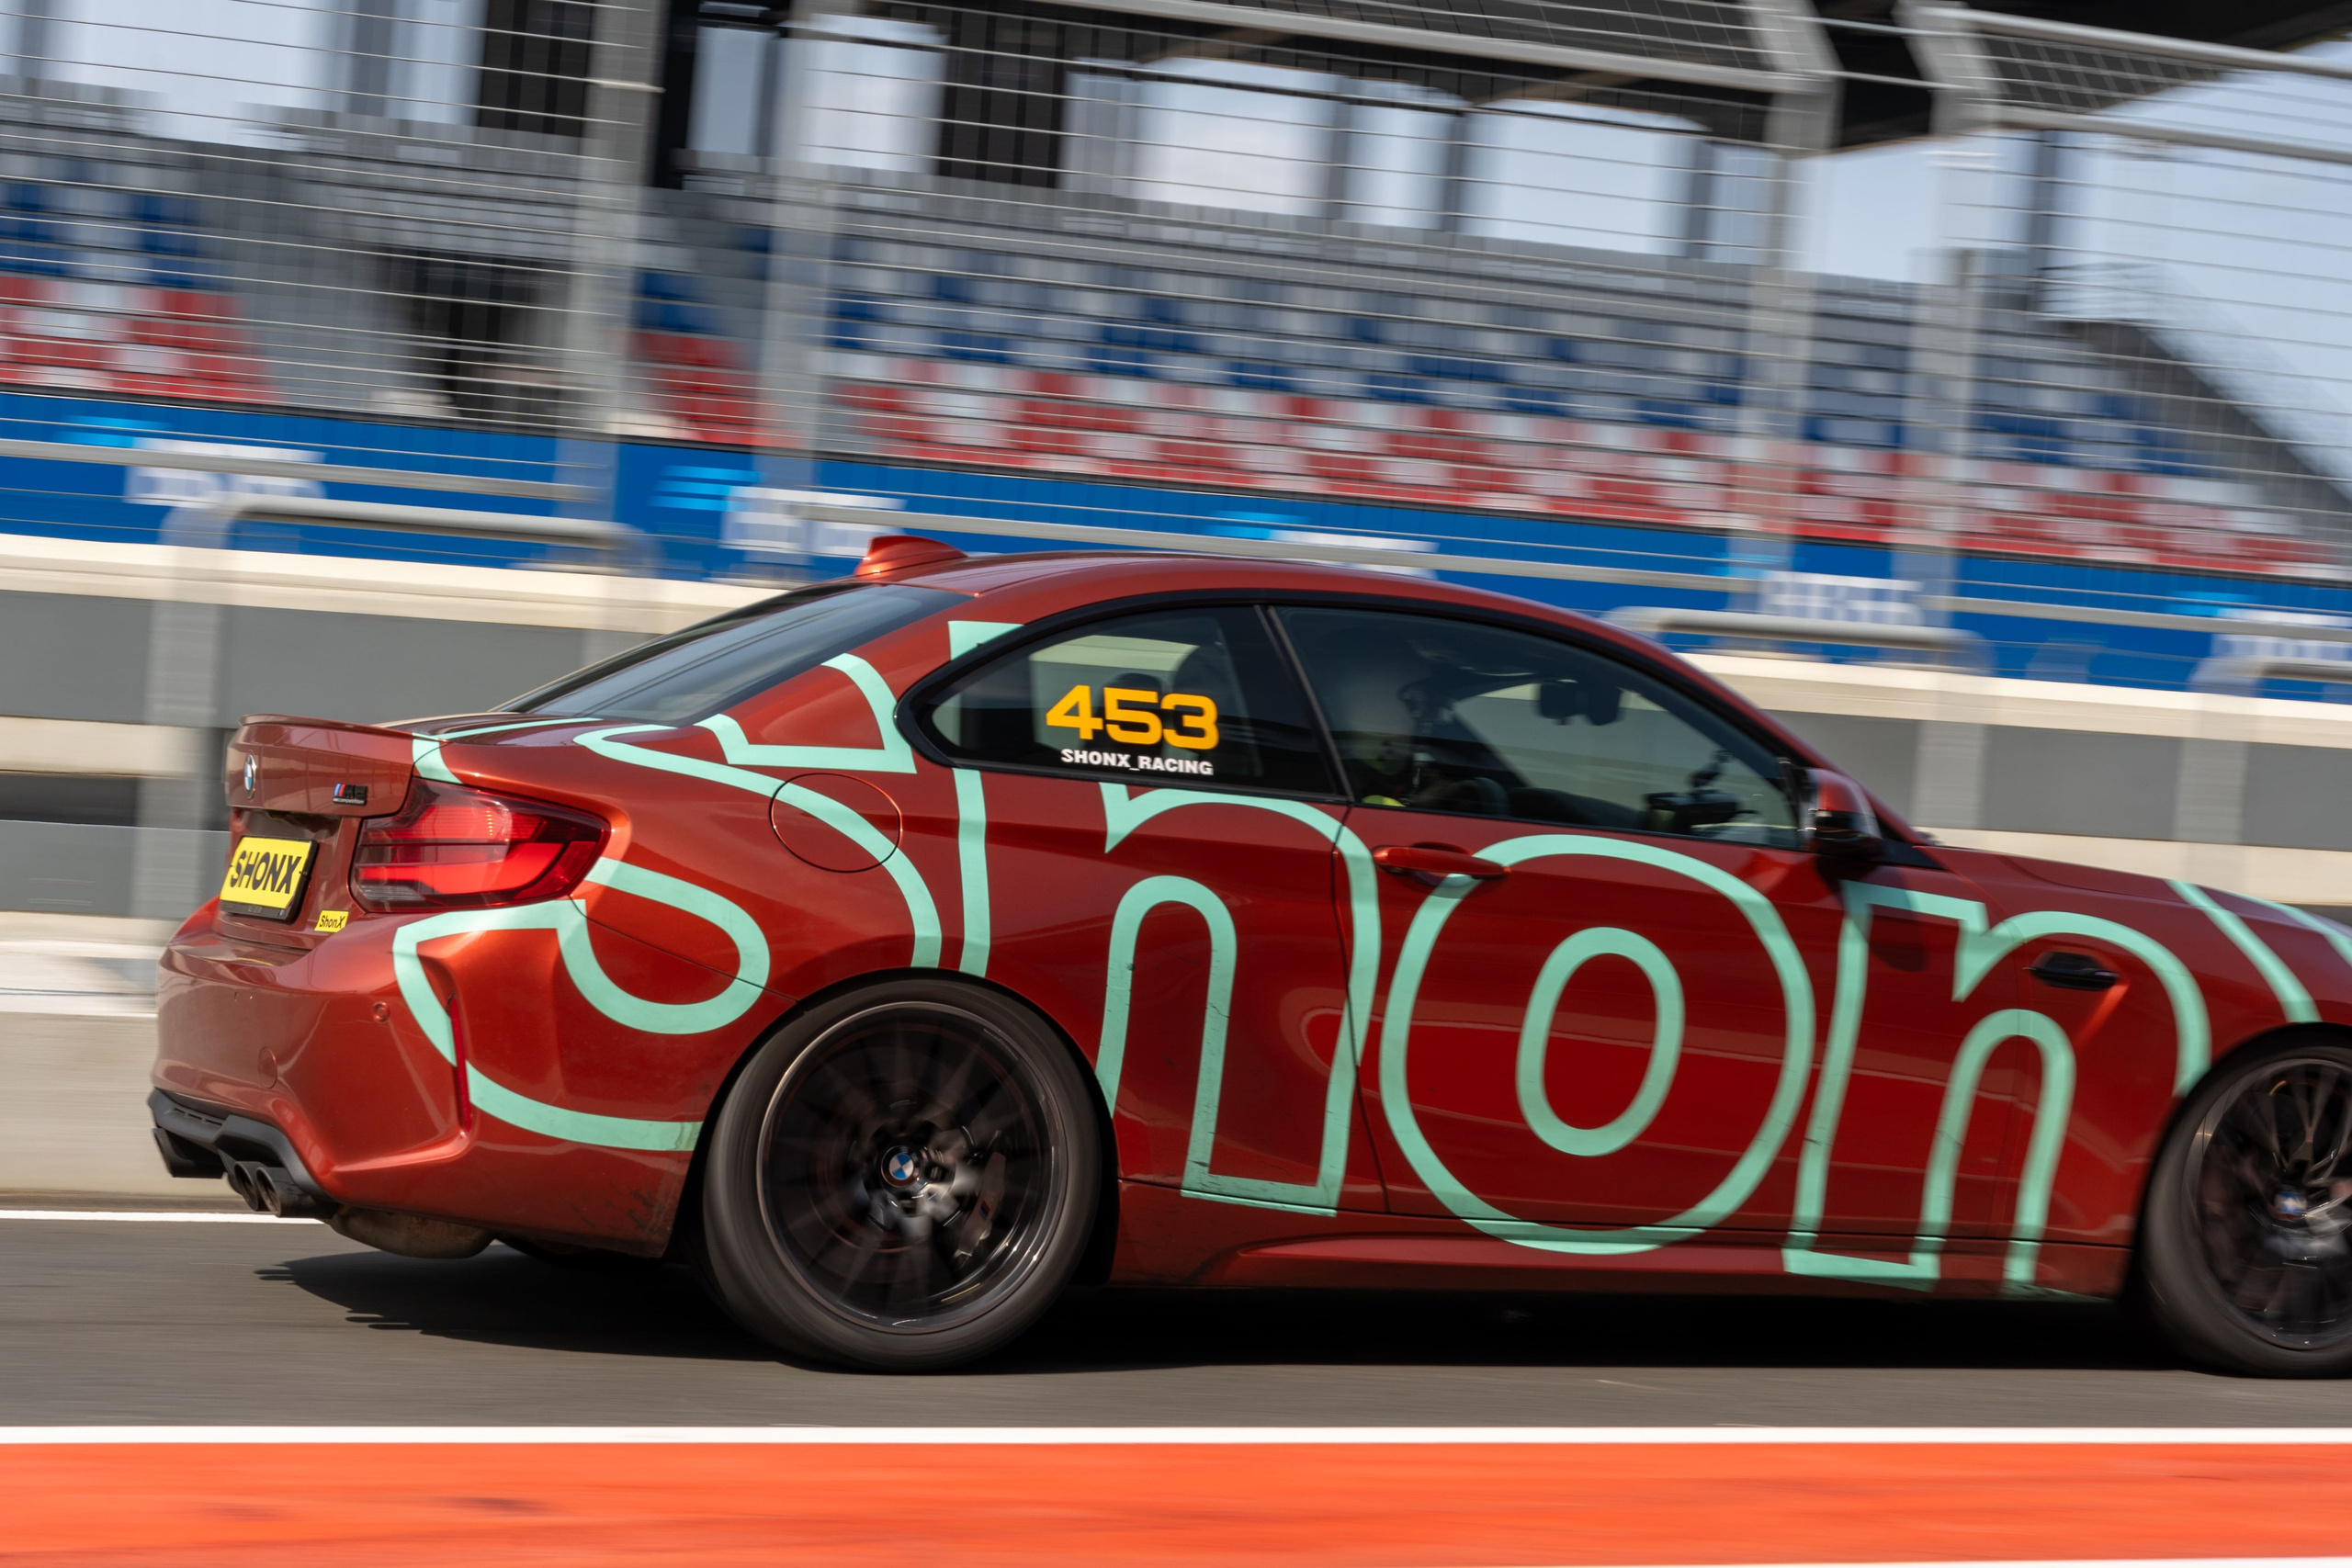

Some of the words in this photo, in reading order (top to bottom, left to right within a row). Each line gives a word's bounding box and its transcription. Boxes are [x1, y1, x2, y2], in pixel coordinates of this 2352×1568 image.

[1046, 684, 1219, 750] 453
[1060, 748, 1214, 775] SHONX_RACING
[230, 850, 302, 894] SHONX
[319, 915, 345, 928] ShonX
